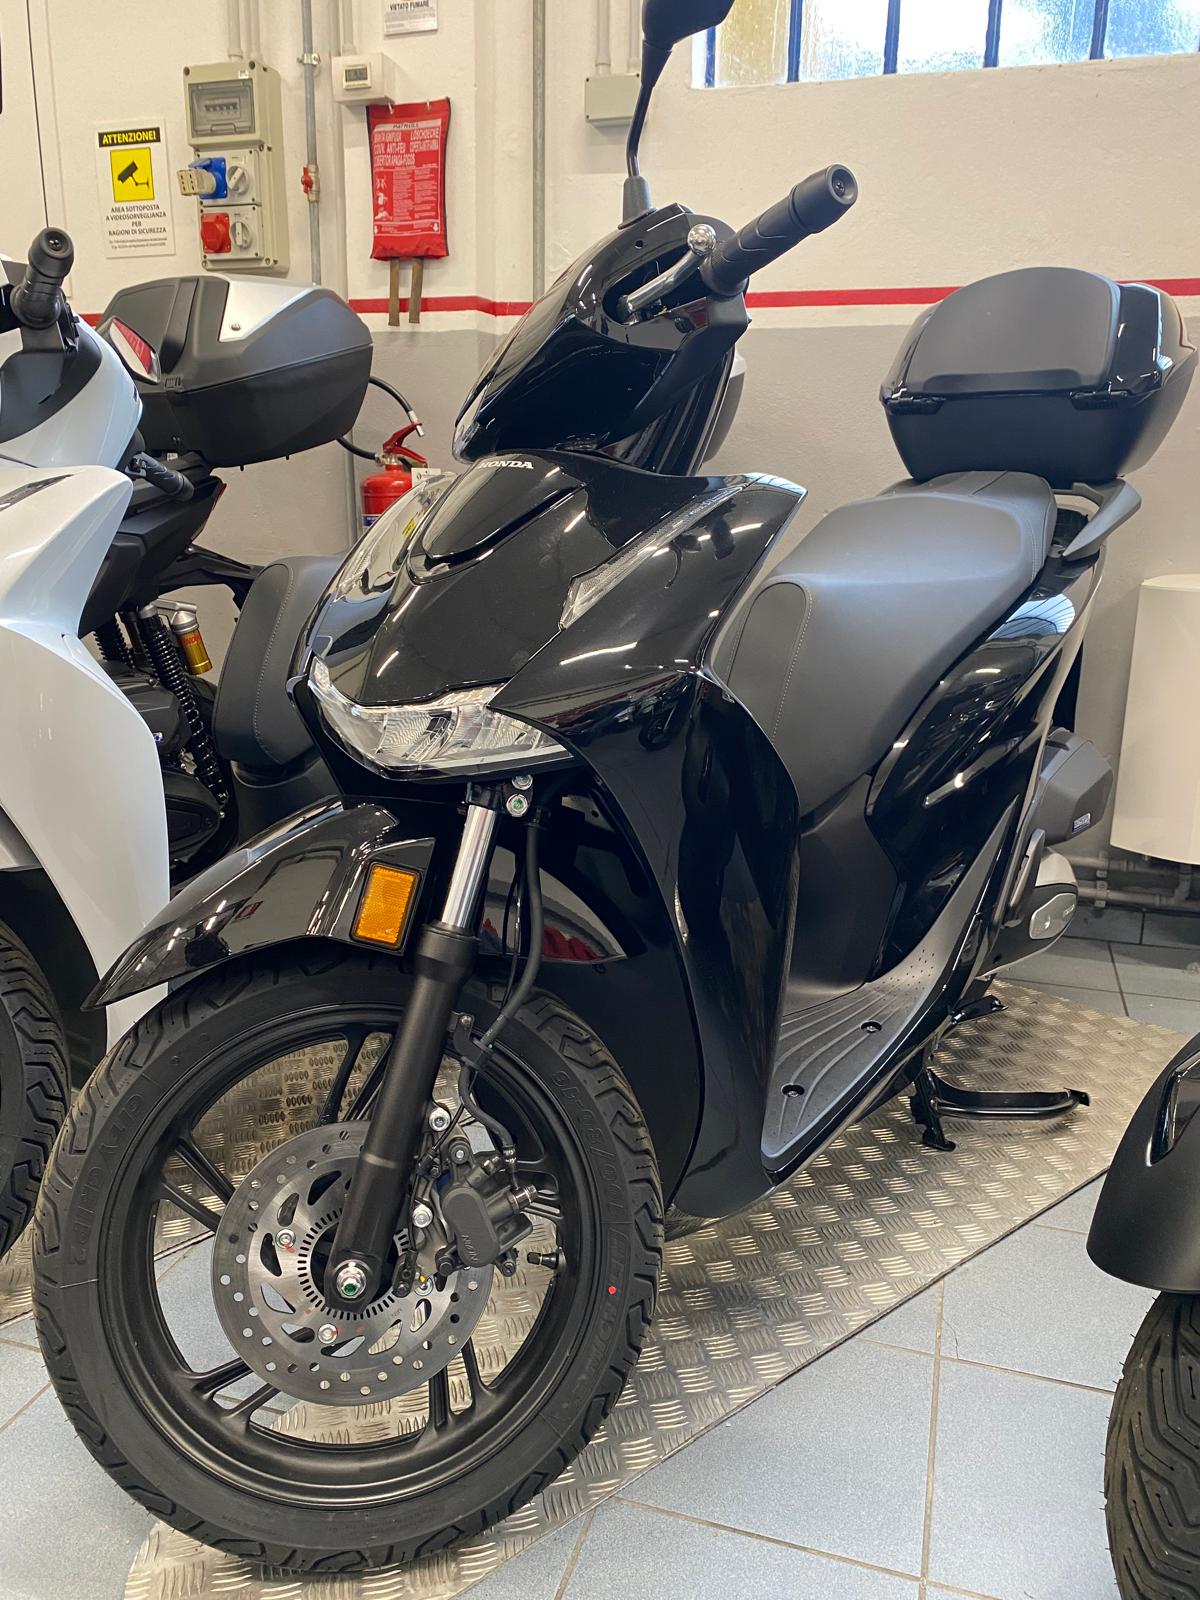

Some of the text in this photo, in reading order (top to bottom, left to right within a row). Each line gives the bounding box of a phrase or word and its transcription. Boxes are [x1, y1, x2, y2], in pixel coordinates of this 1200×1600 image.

[390, 0, 429, 11] VIETATO FUMARE
[102, 130, 157, 145] ATTENZIONE!
[125, 204, 160, 212] SOTTOPOSTA
[110, 211, 166, 221] VIDEOSORVEGLIANZA
[131, 220, 142, 228] PER
[477, 460, 534, 470] HONDA
